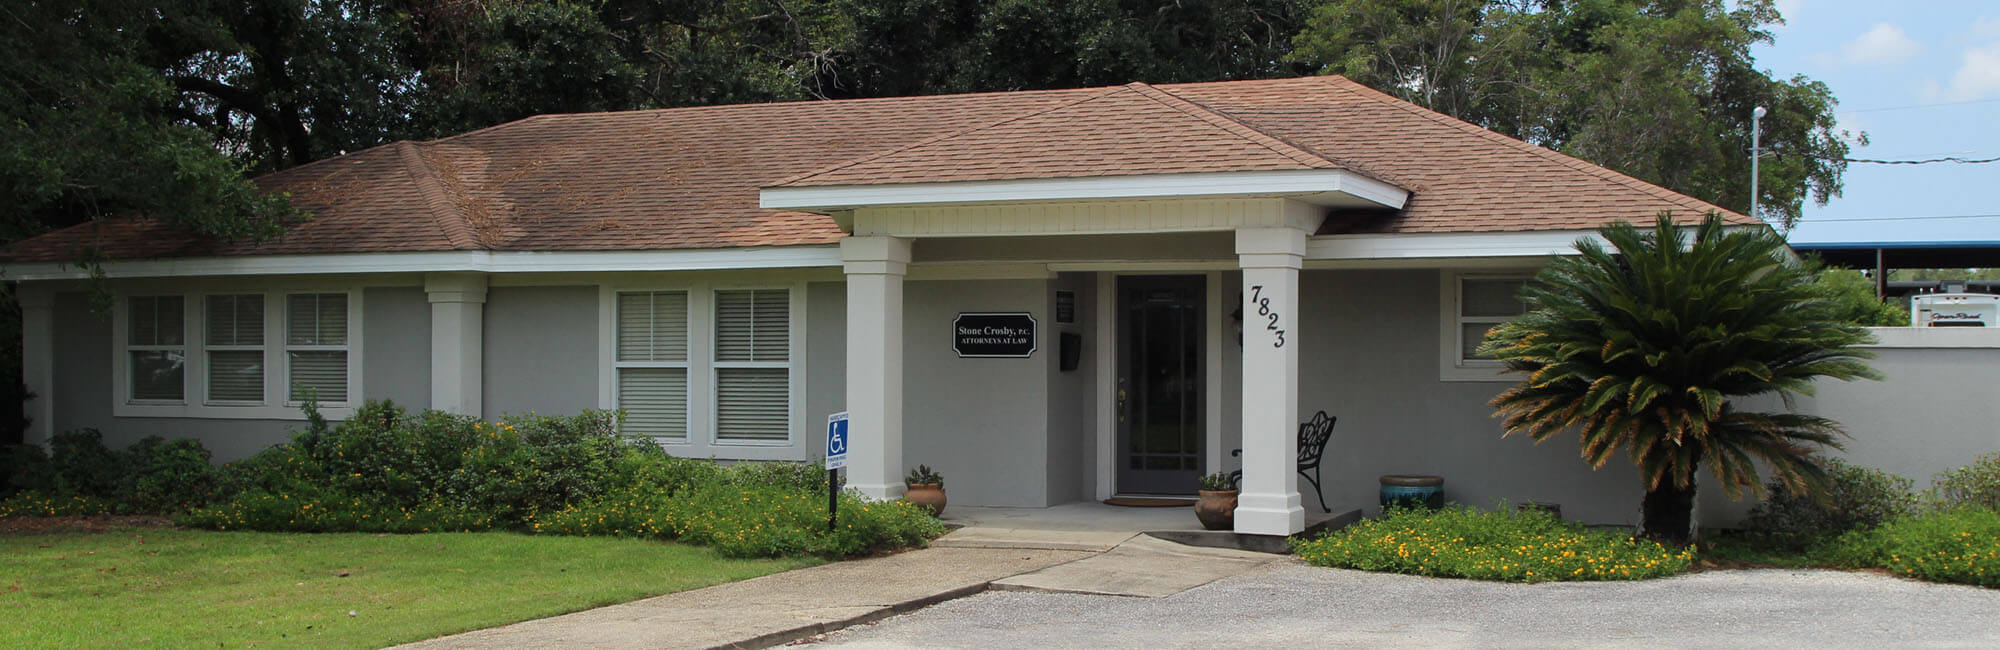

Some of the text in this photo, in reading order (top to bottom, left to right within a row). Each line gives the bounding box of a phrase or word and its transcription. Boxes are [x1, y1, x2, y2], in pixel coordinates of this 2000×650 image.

[959, 326, 982, 335] Stone
[984, 326, 1016, 337] Crosby,
[1251, 285, 1285, 348] 7823
